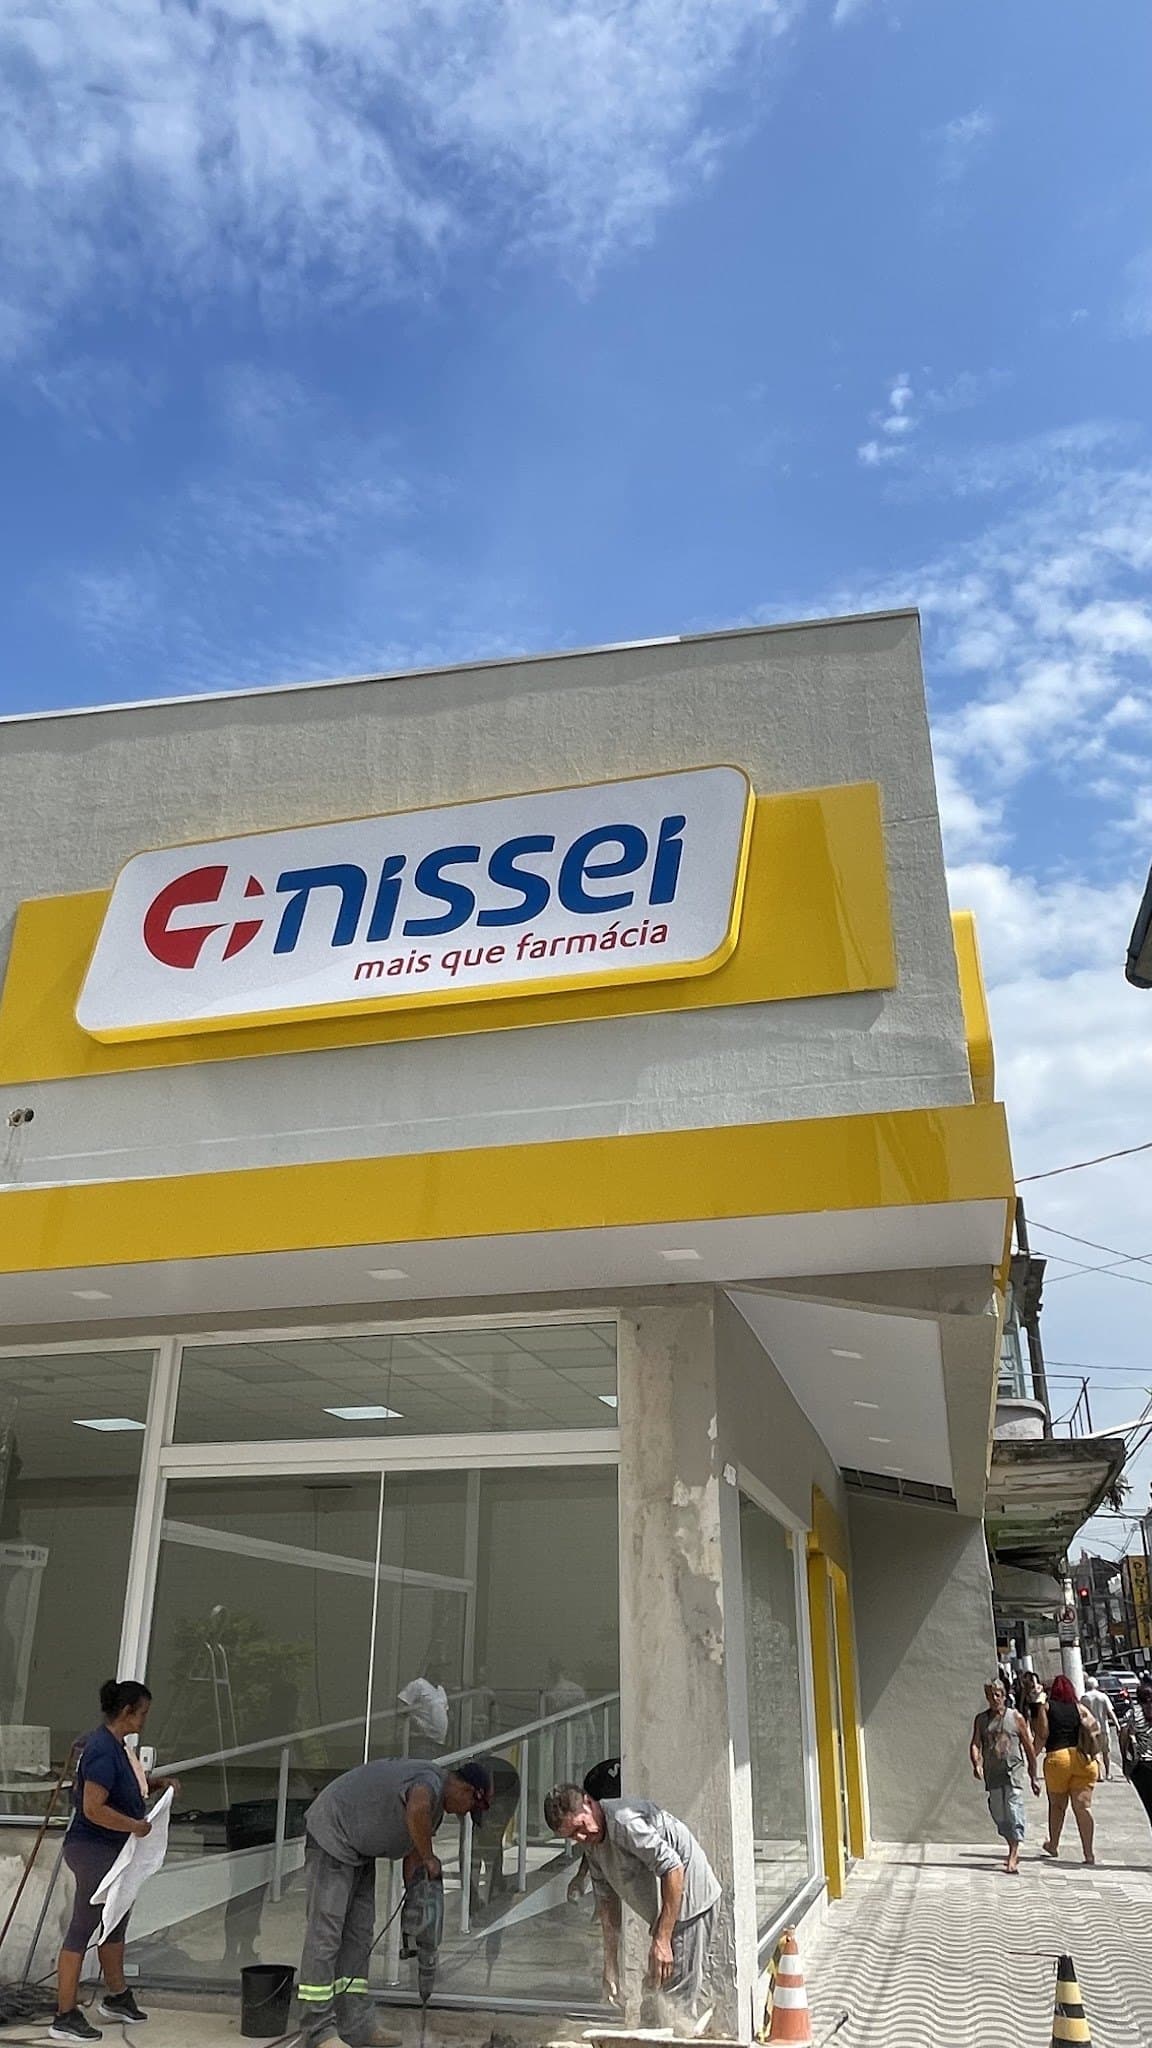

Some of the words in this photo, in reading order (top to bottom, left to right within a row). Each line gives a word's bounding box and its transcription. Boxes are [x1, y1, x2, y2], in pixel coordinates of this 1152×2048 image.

[273, 815, 686, 954] nissei
[355, 950, 430, 981] mais
[441, 945, 505, 976] que
[516, 920, 669, 960] farmácia
